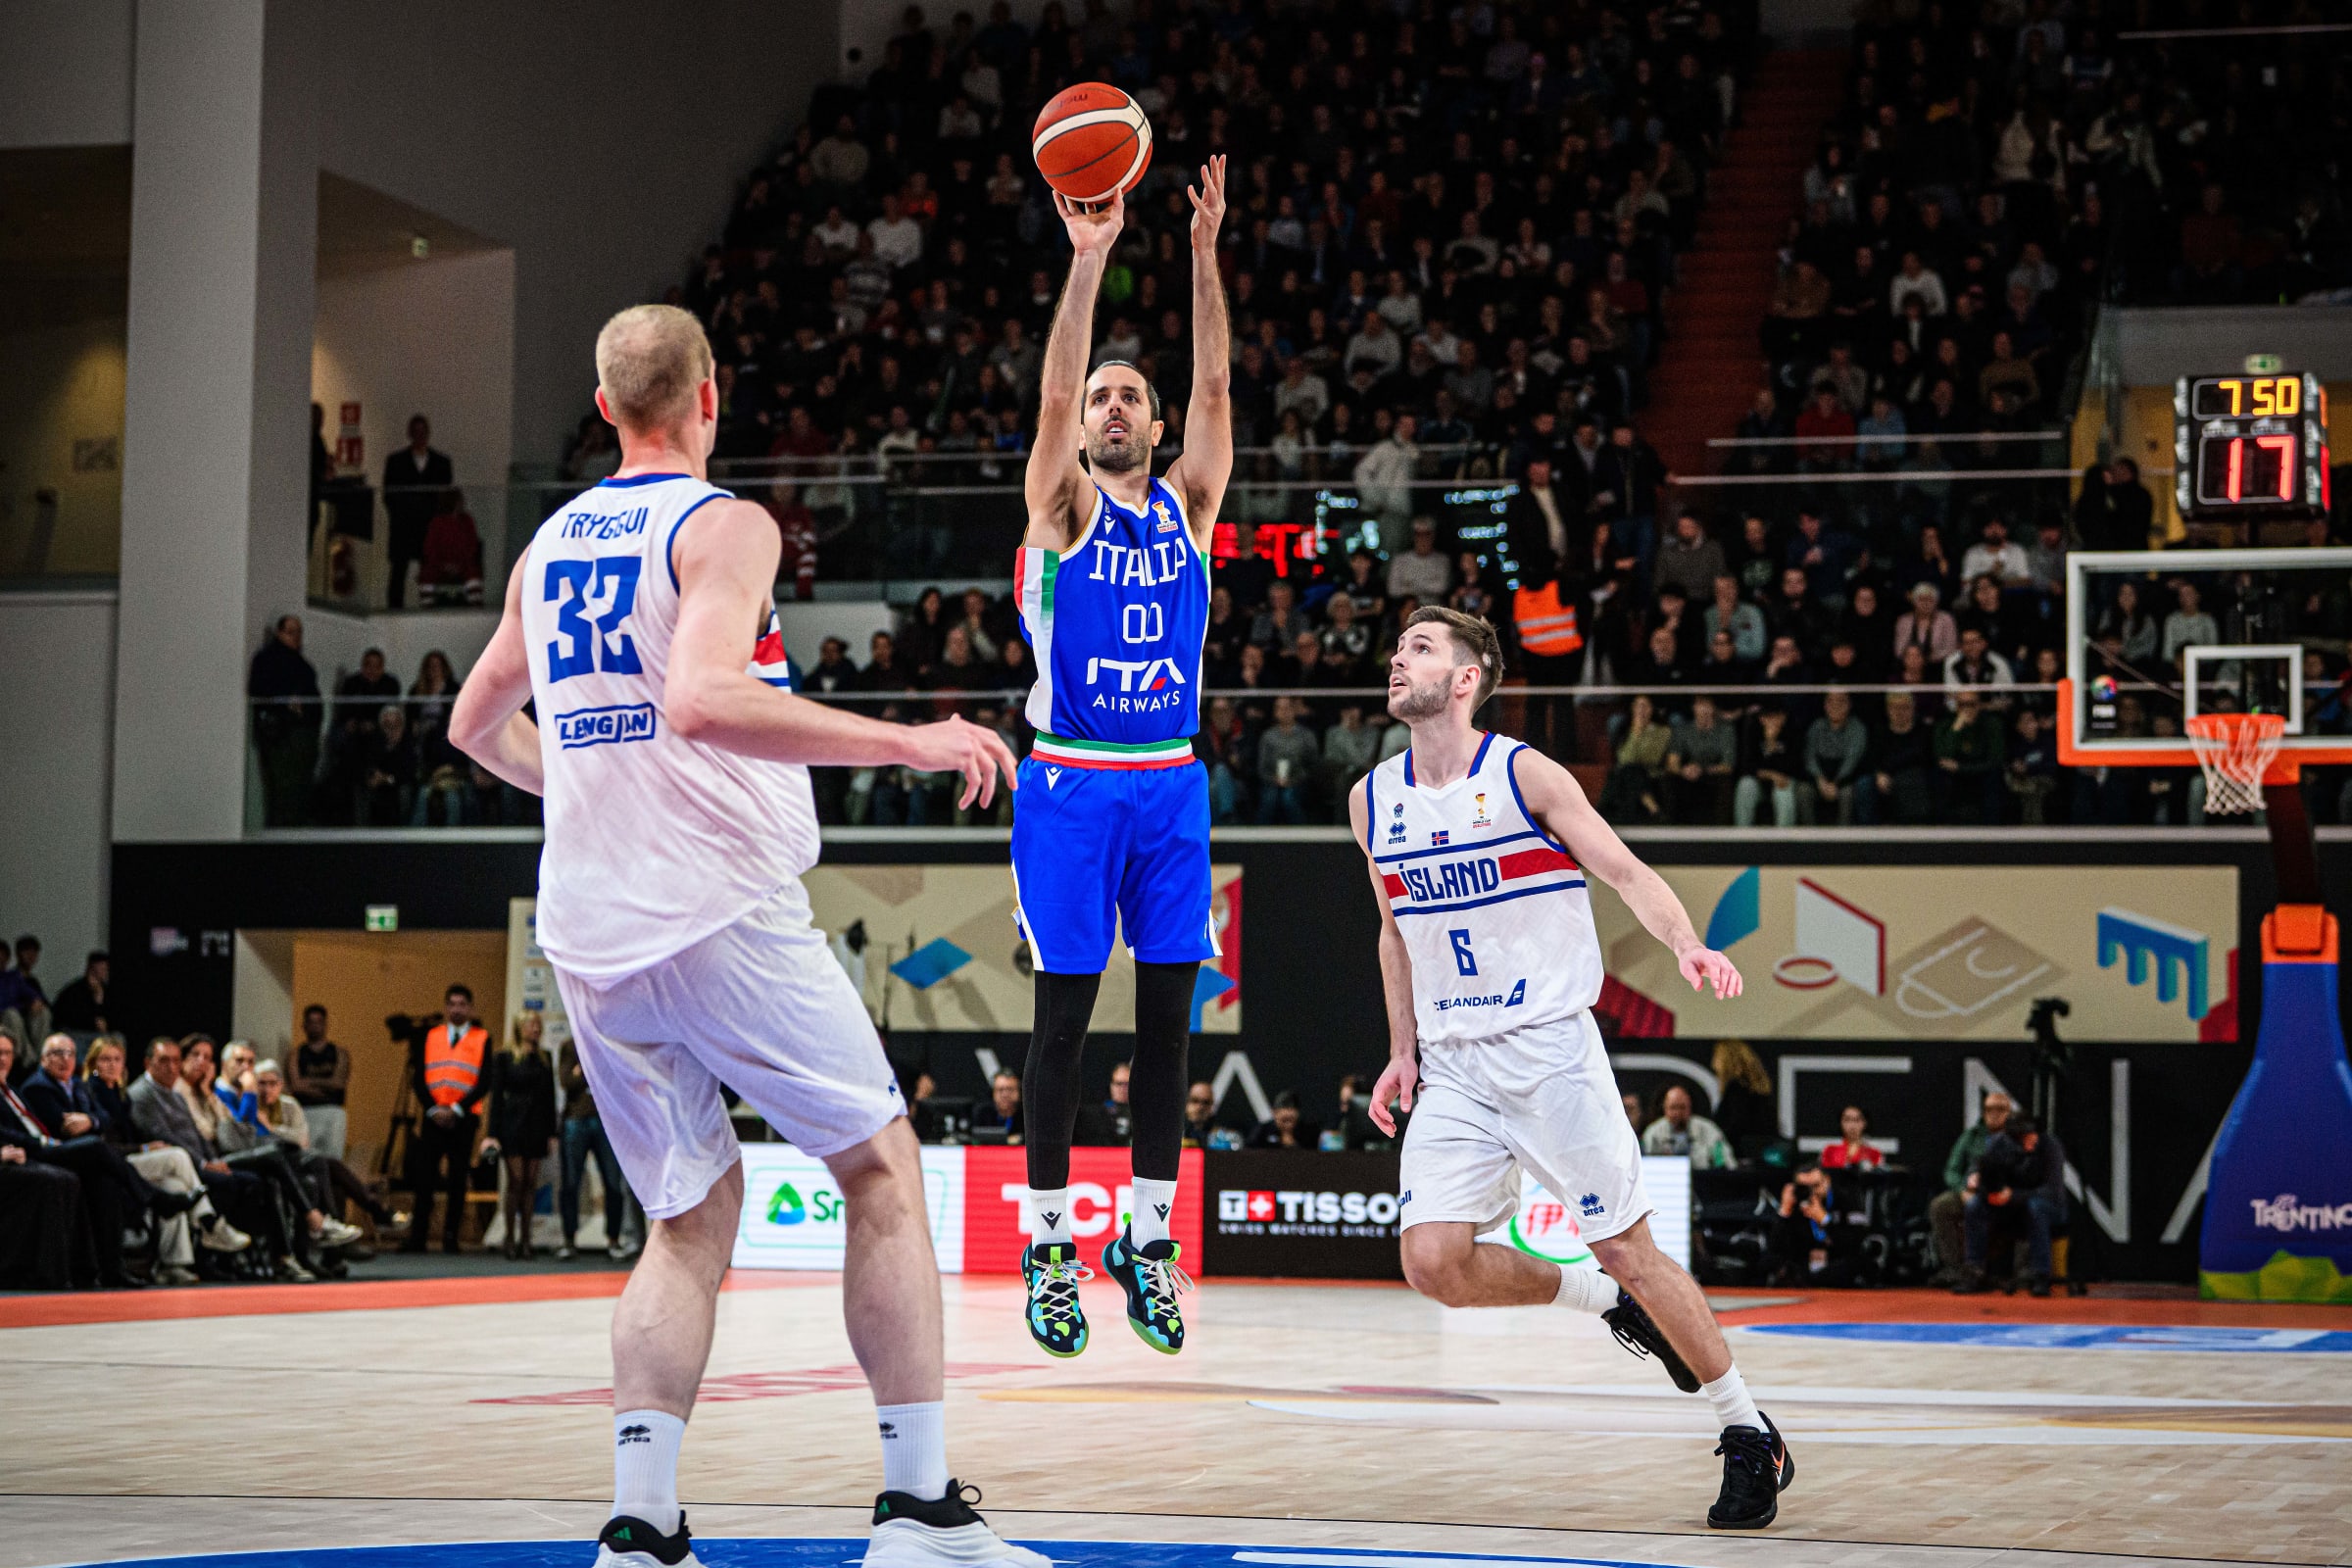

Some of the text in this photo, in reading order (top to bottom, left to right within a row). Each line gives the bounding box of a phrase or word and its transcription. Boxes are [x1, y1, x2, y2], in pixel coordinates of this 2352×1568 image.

[2228, 435, 2294, 503] 17
[1089, 537, 1187, 587] ITALIA
[544, 556, 643, 684] 32
[1086, 658, 1187, 692] ITA
[1093, 691, 1180, 713] AIRWAYS
[1398, 858, 1499, 903] ÍSLAND
[1448, 929, 1478, 976] 6
[1276, 1192, 1400, 1224] TISSO
